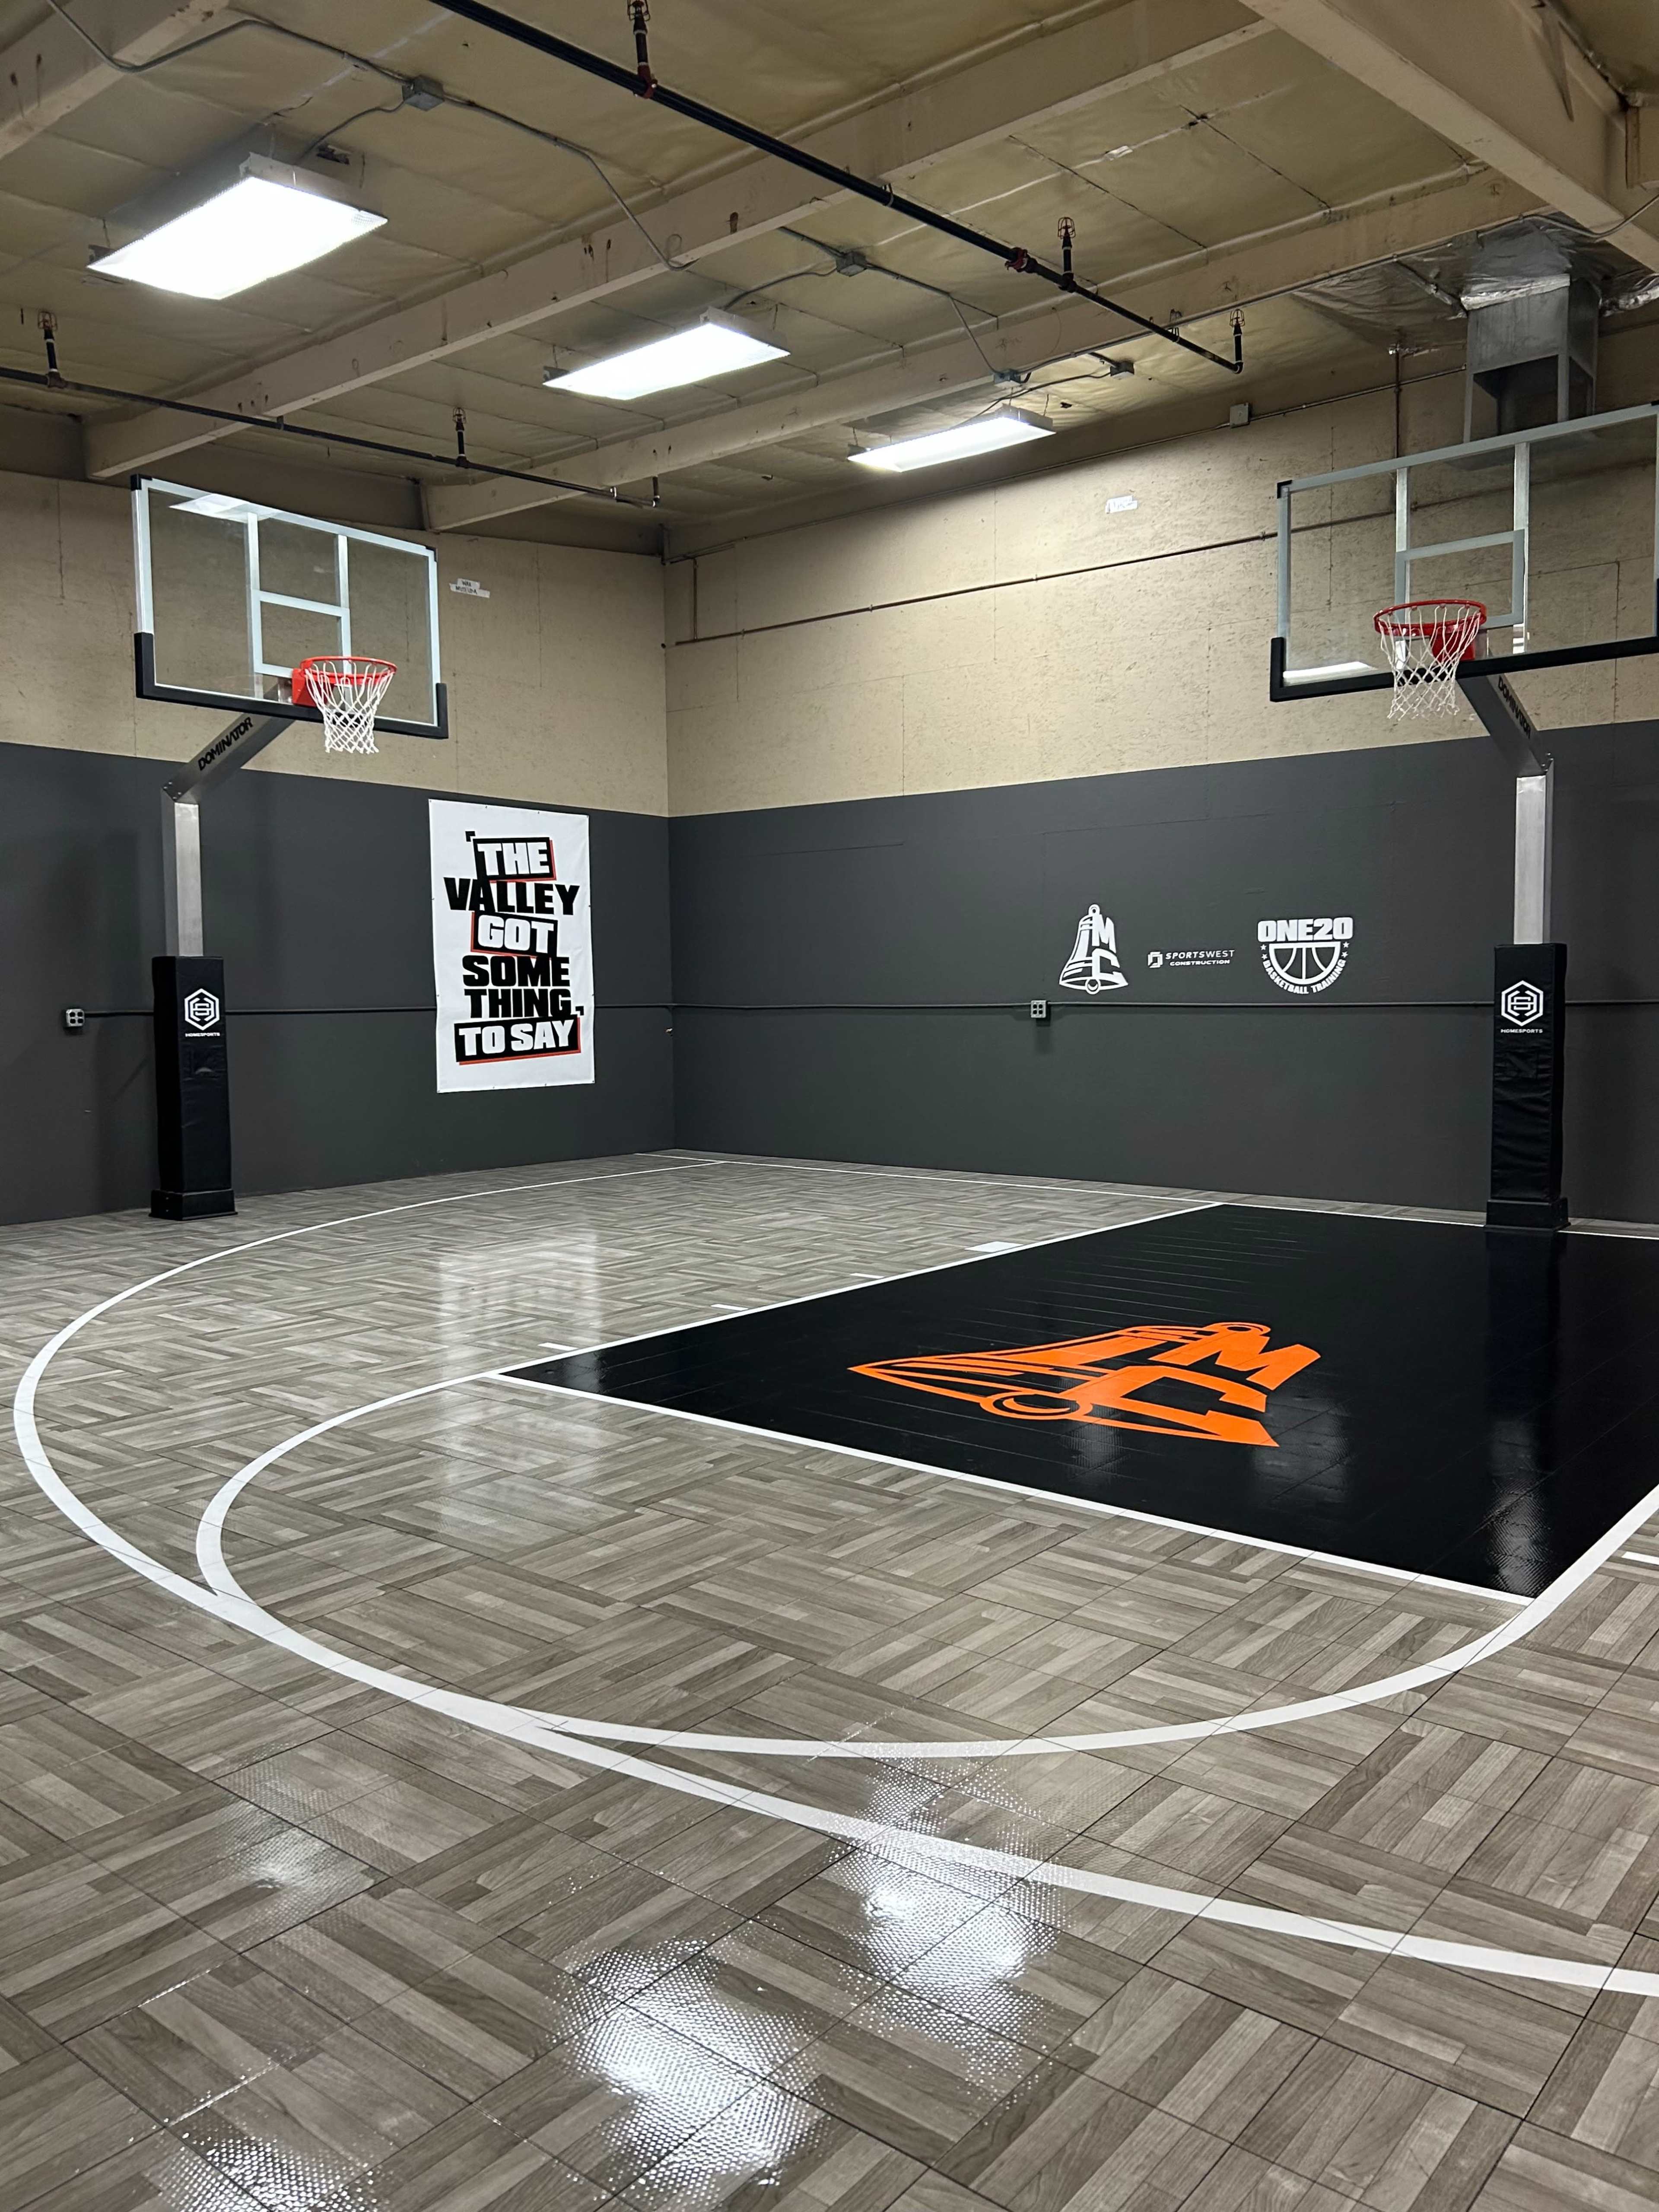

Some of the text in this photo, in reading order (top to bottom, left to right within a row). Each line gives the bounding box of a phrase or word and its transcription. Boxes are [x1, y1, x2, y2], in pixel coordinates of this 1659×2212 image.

[1498, 675, 1531, 739] DOMINATOR
[198, 717, 253, 771] DOMINATOR
[477, 842, 550, 876] THE
[443, 877, 580, 915] VALLEY
[477, 914, 554, 953] GOT
[1257, 917, 1353, 942] ONE20
[462, 955, 570, 987] SOME
[1165, 950, 1235, 960] SPORTSWEST
[1262, 959, 1346, 994] BASKETBALL TRAINING
[464, 988, 572, 1018] THING
[458, 1019, 575, 1056] TO SAY
